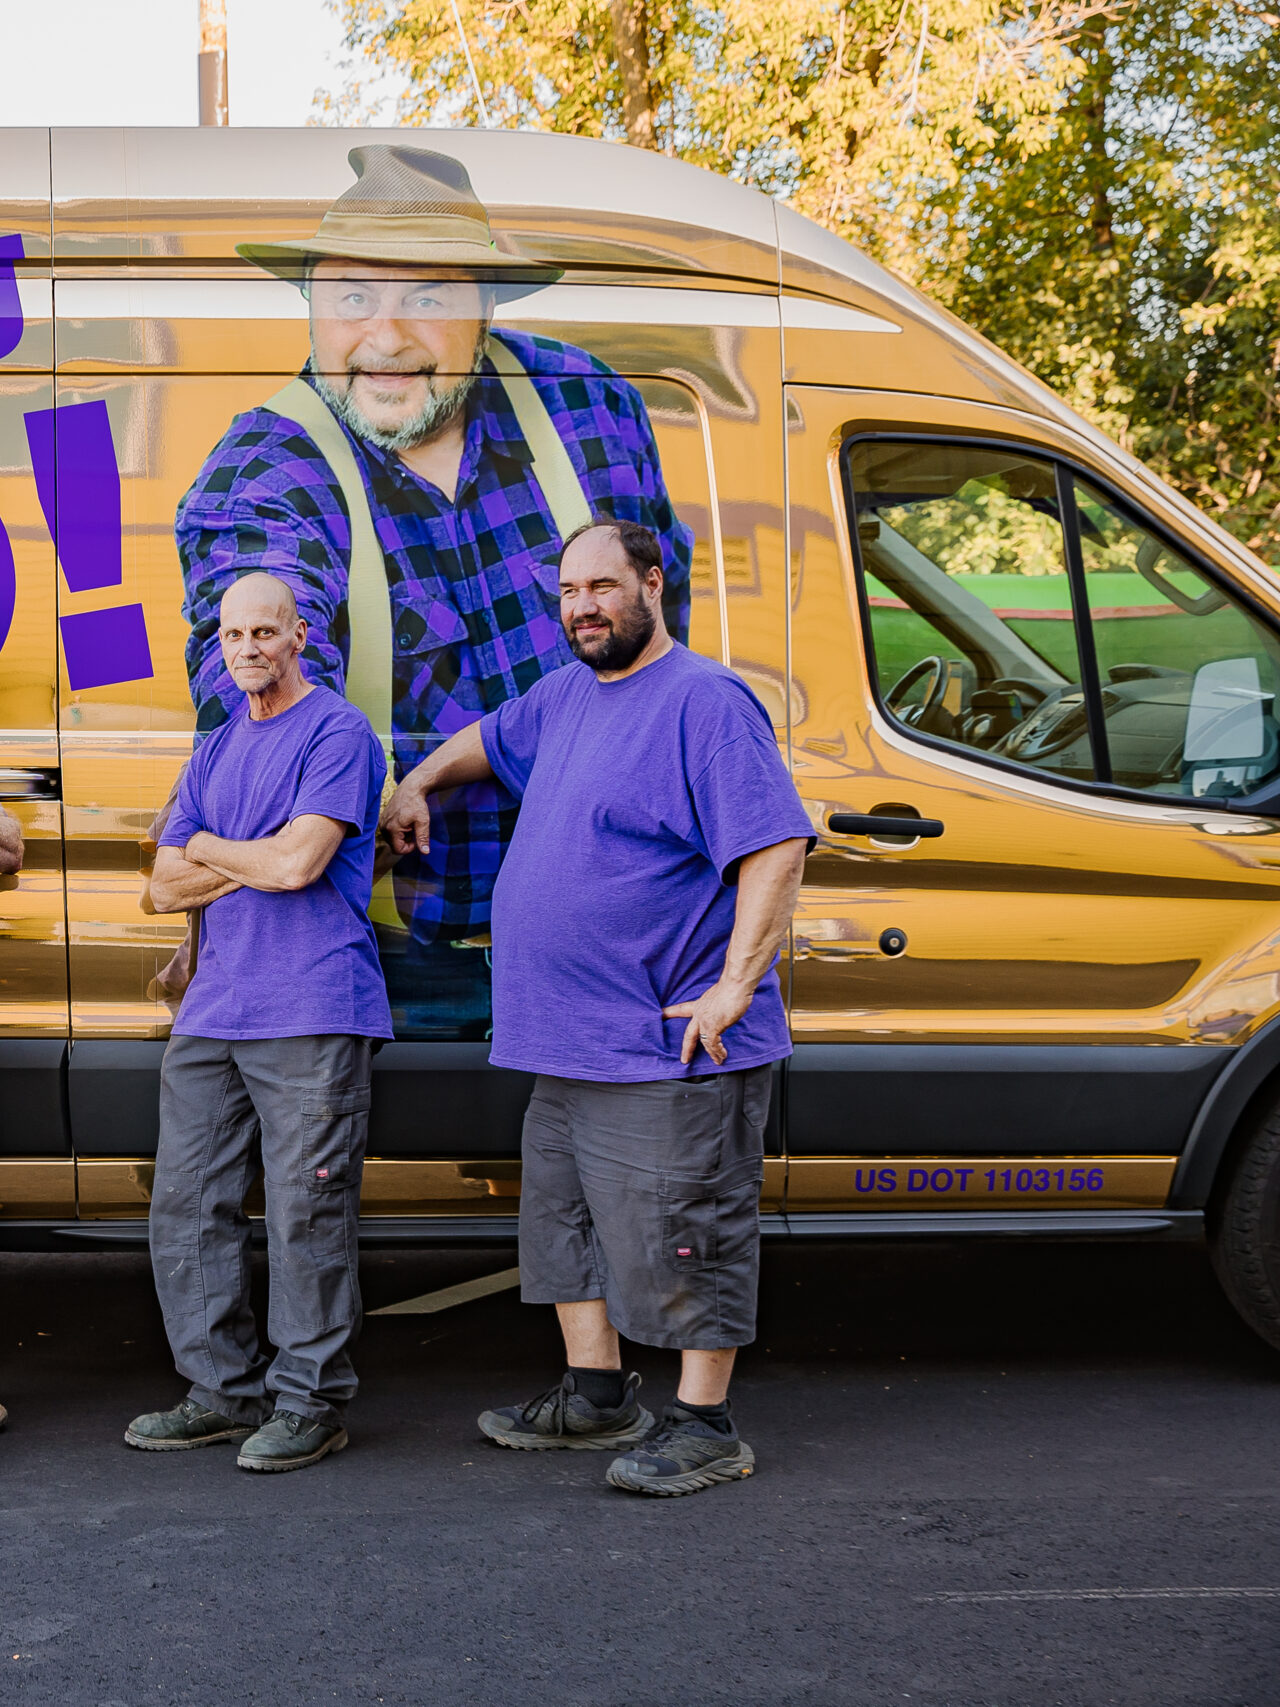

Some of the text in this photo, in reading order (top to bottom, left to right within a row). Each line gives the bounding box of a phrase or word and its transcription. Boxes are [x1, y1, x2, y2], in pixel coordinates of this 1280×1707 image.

[854, 1168, 1104, 1193] US DOT 1103156
